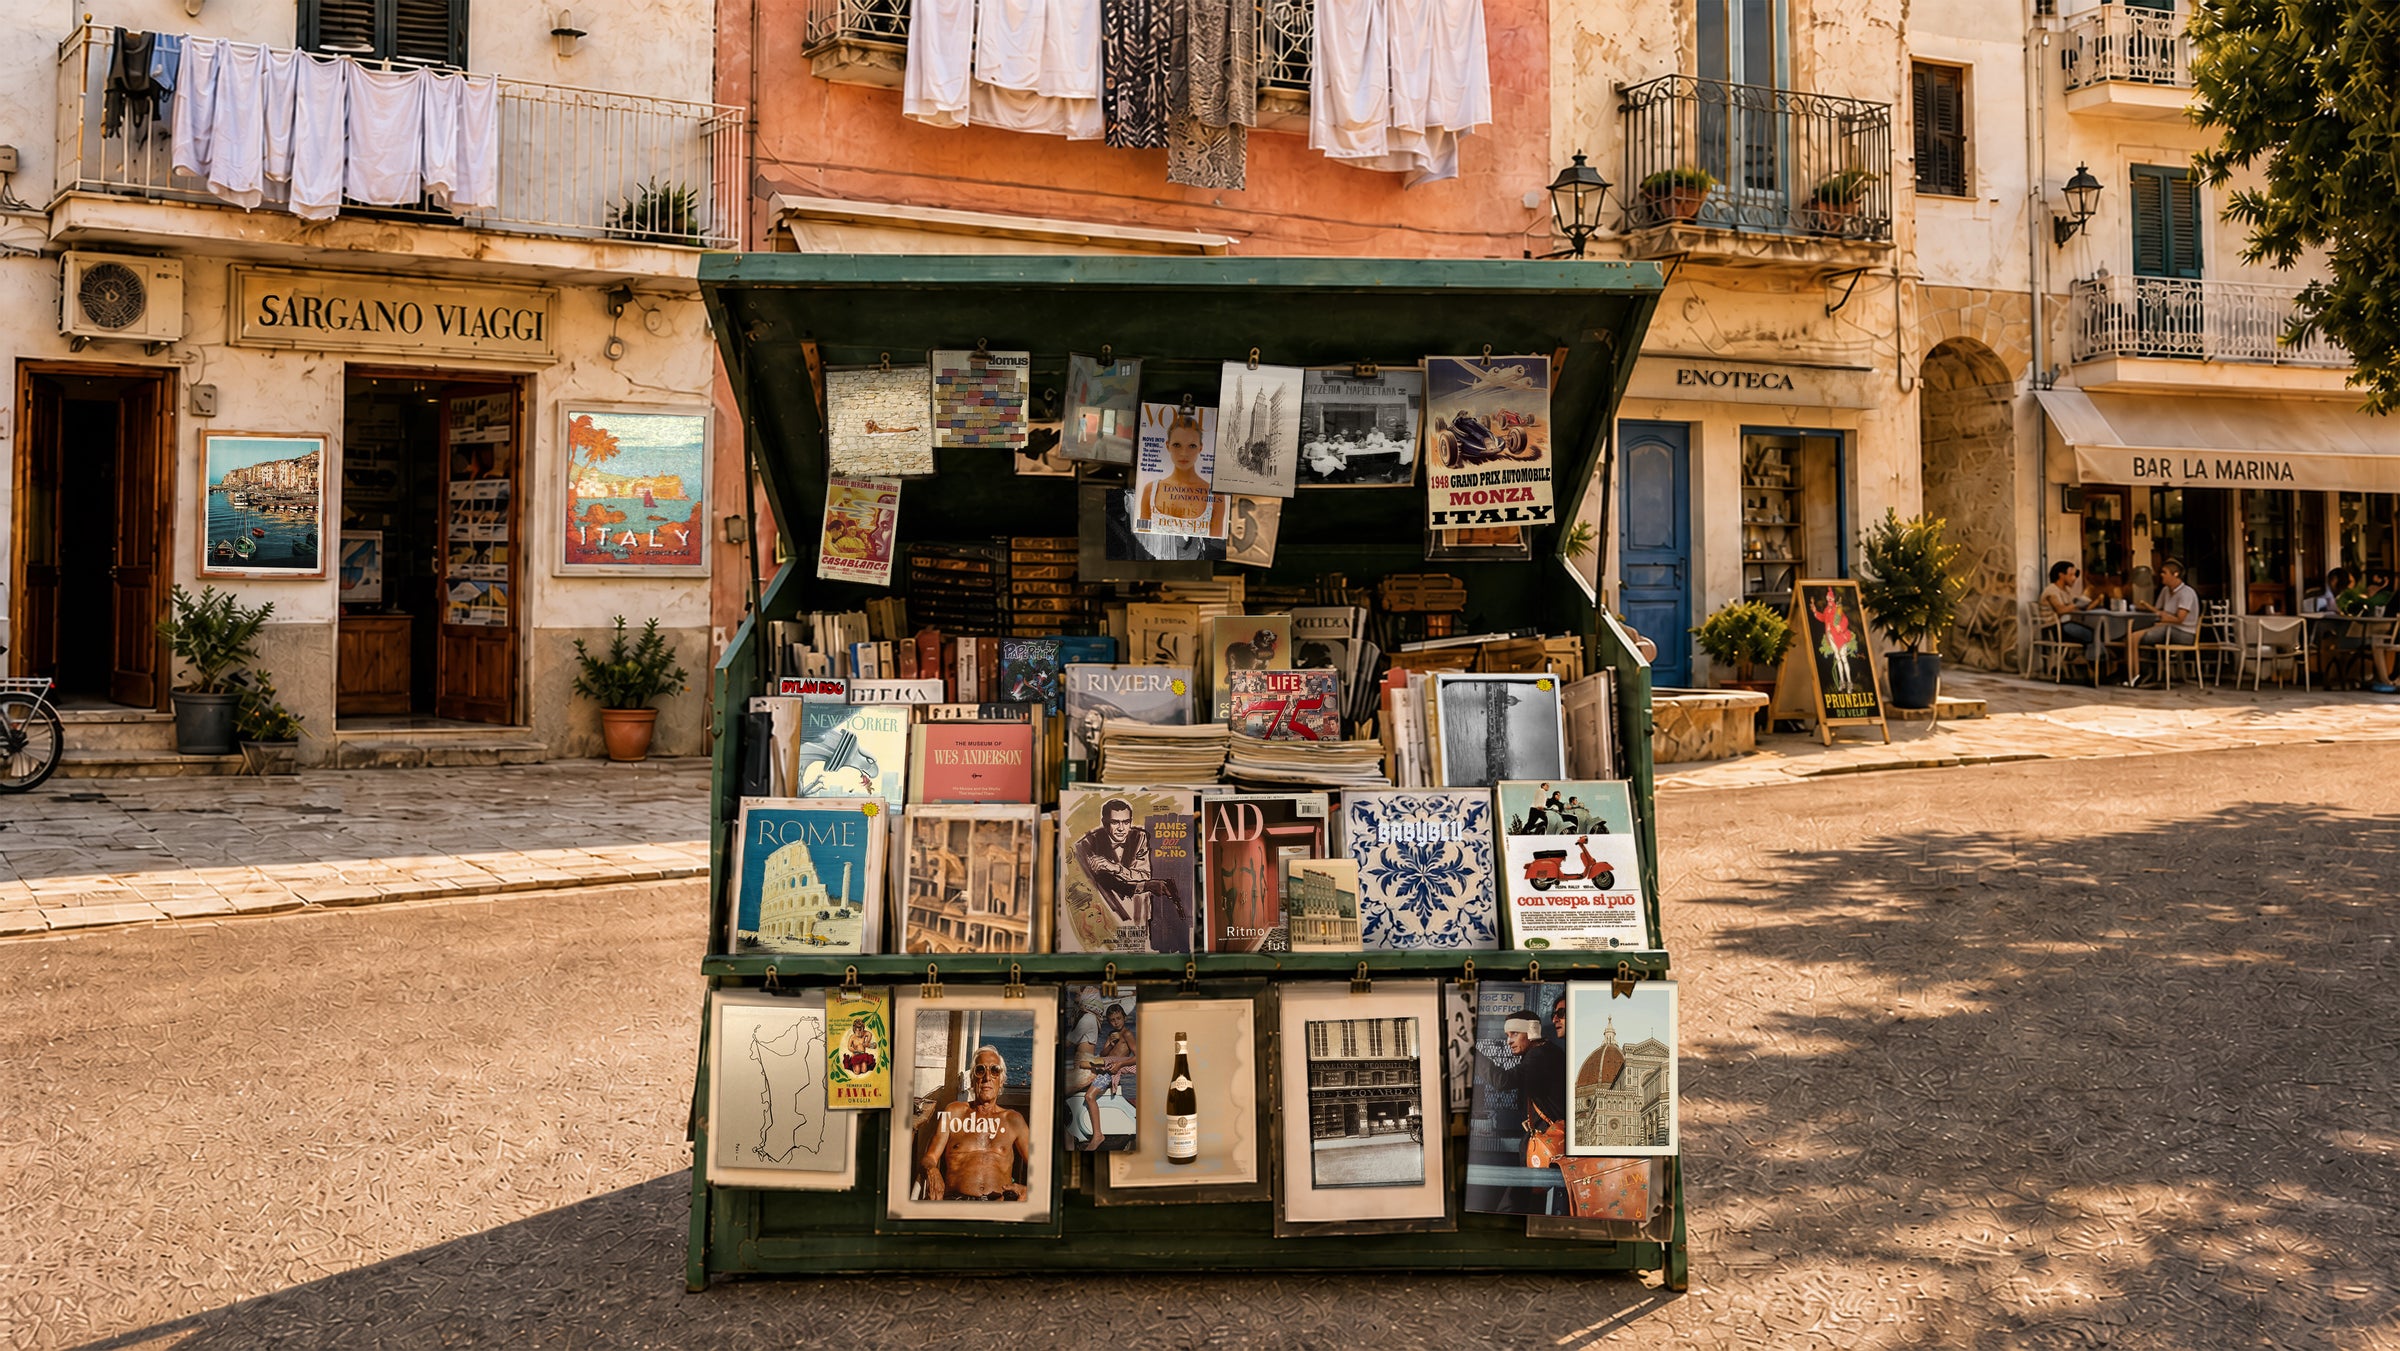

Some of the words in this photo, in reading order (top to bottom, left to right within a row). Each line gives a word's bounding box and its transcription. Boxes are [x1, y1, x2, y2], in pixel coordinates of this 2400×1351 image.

[258, 294, 424, 334] SARGANO
[434, 303, 545, 342] VIAGGI
[988, 354, 1029, 366] domus
[1676, 368, 1795, 390] ENOTECA
[1305, 384, 1341, 395] PIZZERIA
[1350, 385, 1397, 397] NAPOLETANA
[2133, 457, 2172, 478] BAR
[2183, 458, 2208, 479] LA
[2215, 459, 2295, 482] MARINA
[1431, 475, 1449, 489] 1948
[1450, 473, 1478, 488] GRAND
[1479, 470, 1501, 486] PRIX
[1501, 467, 1551, 484] AUTOMOBILE
[1164, 485, 1194, 494] LONDON
[1449, 487, 1535, 506] MONZA
[1170, 493, 1200, 502] LONDON
[1201, 495, 1224, 503] GIRLS
[1432, 505, 1553, 525] ITALY
[579, 526, 690, 548] ITALY
[821, 556, 889, 571] CASABLANCA
[781, 679, 818, 695] DYLAN
[818, 680, 844, 695] DOG
[1087, 673, 1173, 692] RIVIERA
[1268, 676, 1299, 690] LIFE
[1825, 691, 1876, 708] PRUNELLE
[1836, 709, 1846, 717] DU
[1847, 708, 1869, 717] VELAY
[809, 713, 842, 728] NEW
[842, 714, 898, 732] YORKER
[934, 749, 959, 765] WES
[961, 749, 1023, 766] ANDERSON
[1154, 822, 1188, 831] JAMES
[1207, 803, 1264, 842] AD
[757, 819, 855, 847] ROME
[1155, 830, 1188, 839] BOND
[1378, 821, 1464, 848] BABYBLU
[1162, 838, 1180, 846] 007
[1517, 896, 1545, 907] con
[1545, 896, 1591, 909] vespa
[1592, 893, 1606, 906] si
[1226, 926, 1265, 937] Ritmo
[1267, 940, 1288, 951] fut
[1492, 1005, 1522, 1013] OFFICE
[837, 1087, 867, 1098] FAVA
[1350, 1088, 1403, 1098] GOYARD
[936, 1111, 1006, 1140] Today.
